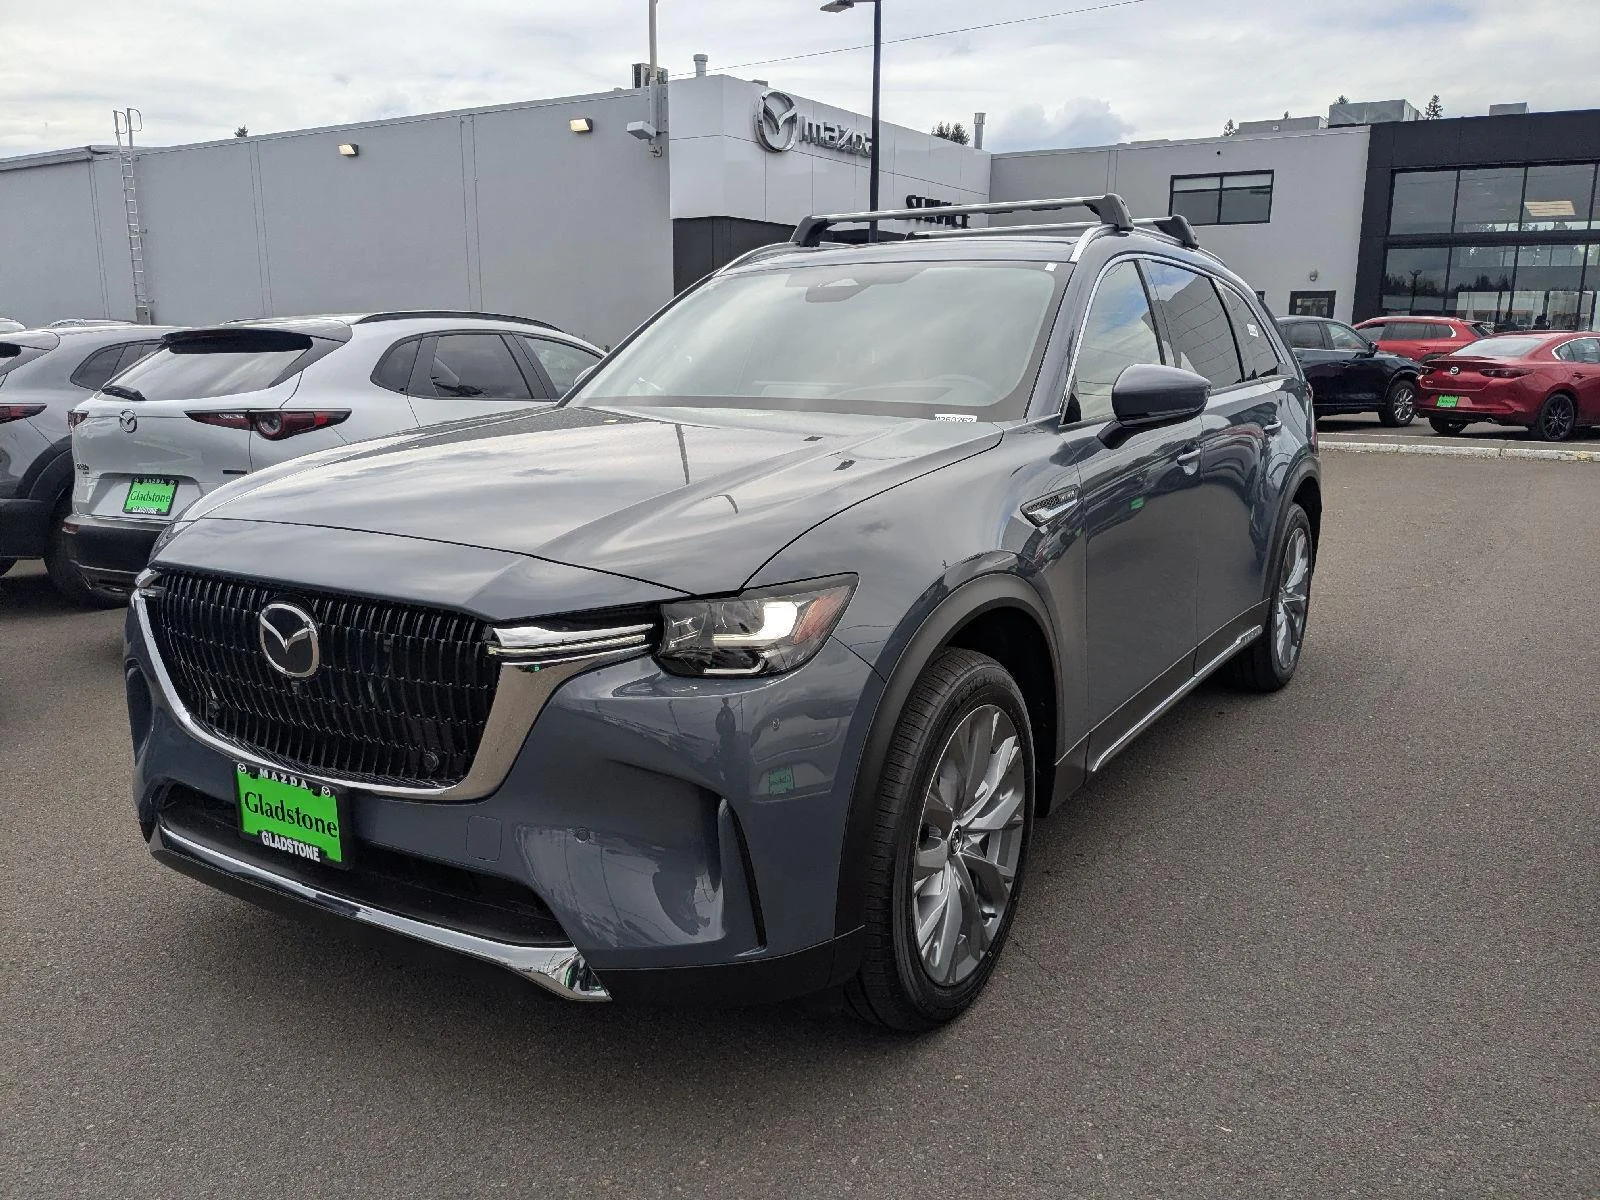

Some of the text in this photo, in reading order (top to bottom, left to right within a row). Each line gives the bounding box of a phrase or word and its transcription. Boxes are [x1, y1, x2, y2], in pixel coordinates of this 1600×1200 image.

[130, 490, 171, 503] Gladstone
[259, 768, 309, 790] MAZDA
[244, 791, 338, 838] Gladstone
[261, 830, 321, 863] GLADSTONE
